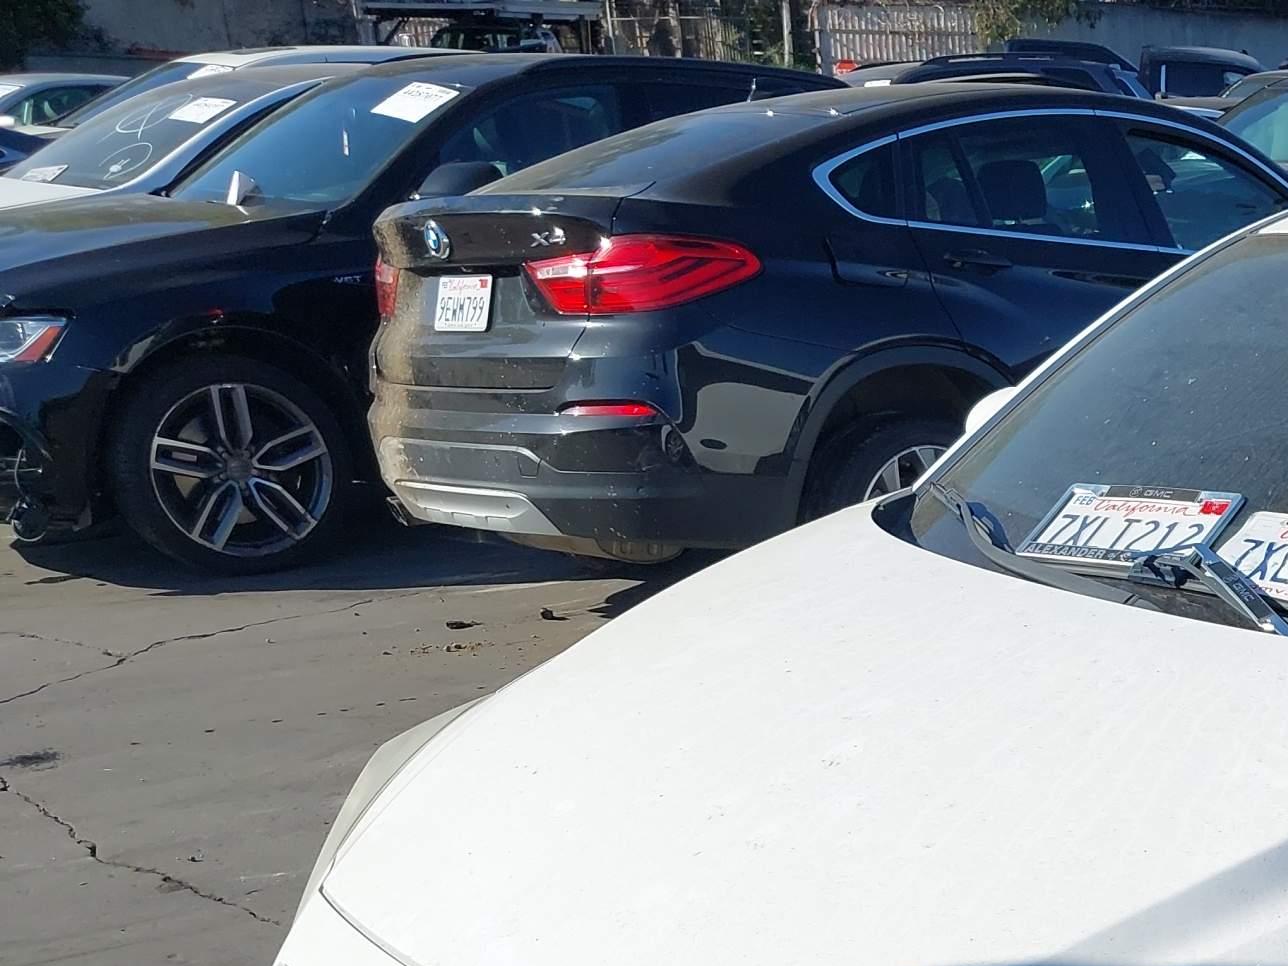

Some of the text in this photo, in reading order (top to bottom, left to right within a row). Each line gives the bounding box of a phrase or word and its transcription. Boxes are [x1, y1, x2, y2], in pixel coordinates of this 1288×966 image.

[530, 226, 567, 248] X4
[1072, 495, 1097, 506] FEB
[1143, 490, 1173, 498] GMC
[1093, 498, 1199, 517] California
[1024, 543, 1106, 559] ALEXANDER
